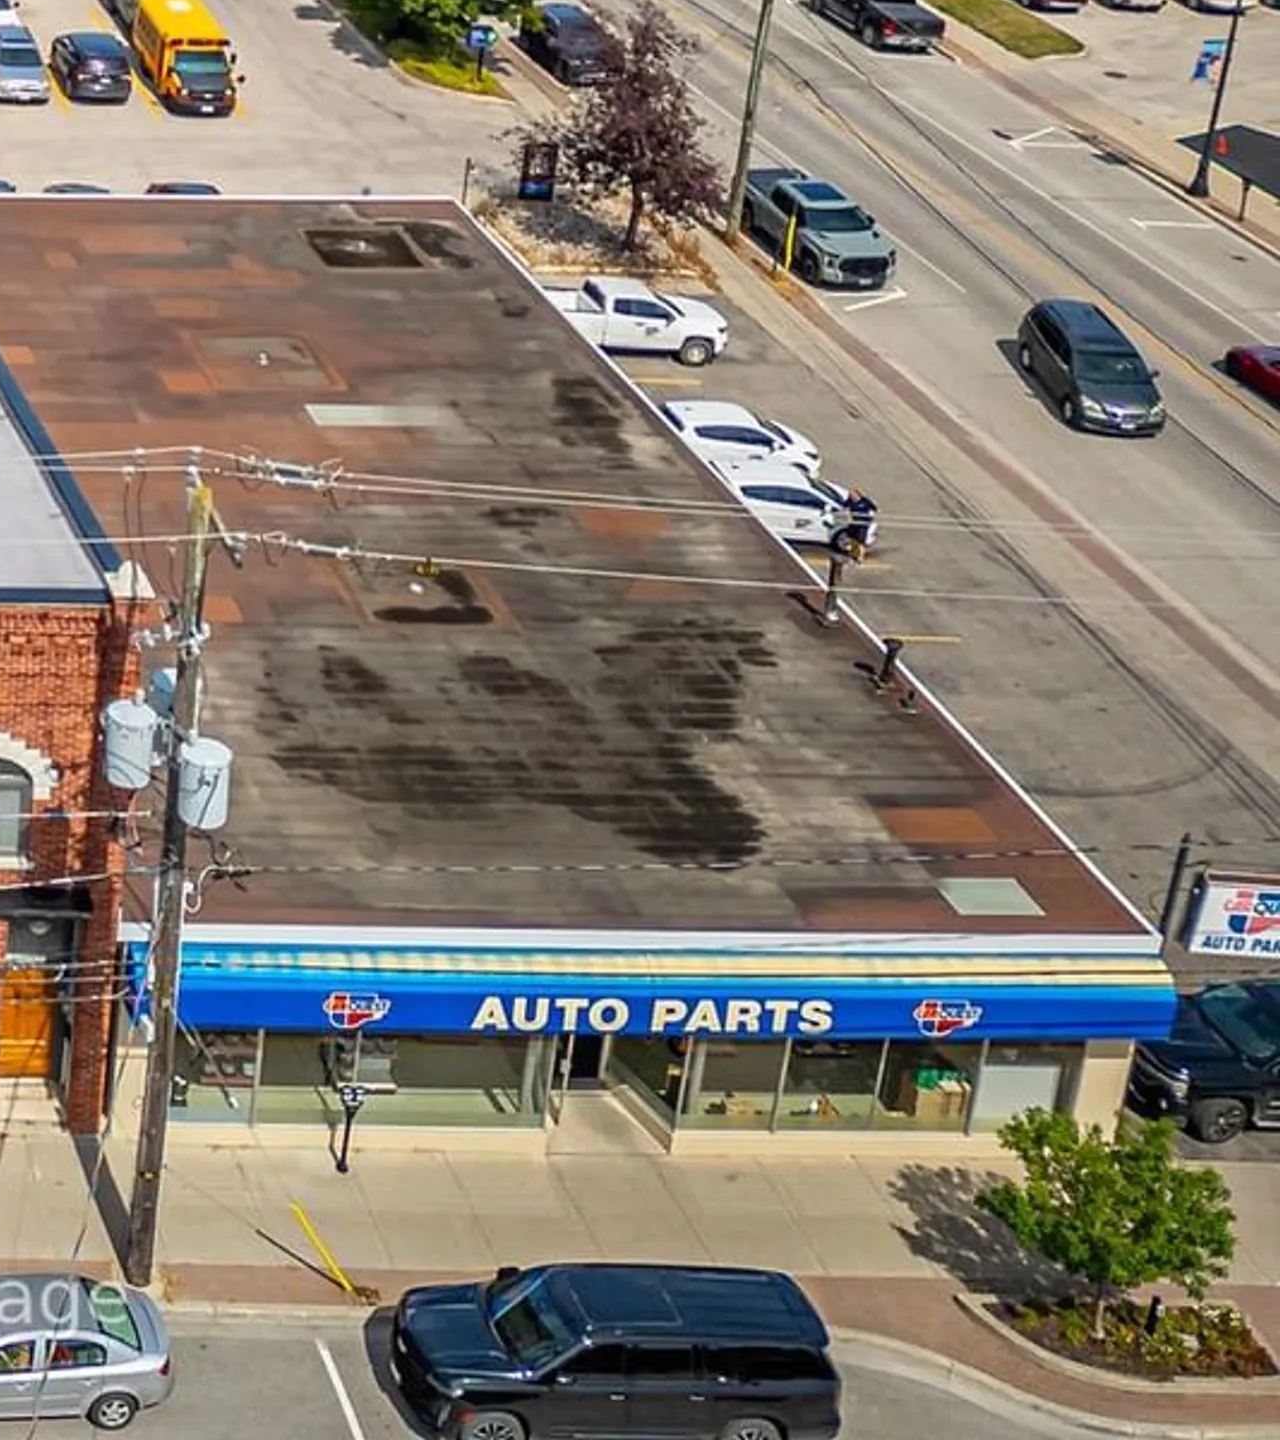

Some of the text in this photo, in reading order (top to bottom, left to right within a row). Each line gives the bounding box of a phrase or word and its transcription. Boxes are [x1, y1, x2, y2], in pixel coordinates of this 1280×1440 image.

[1201, 935, 1247, 951] AUTO
[471, 996, 833, 1034] AUTO PARTS
